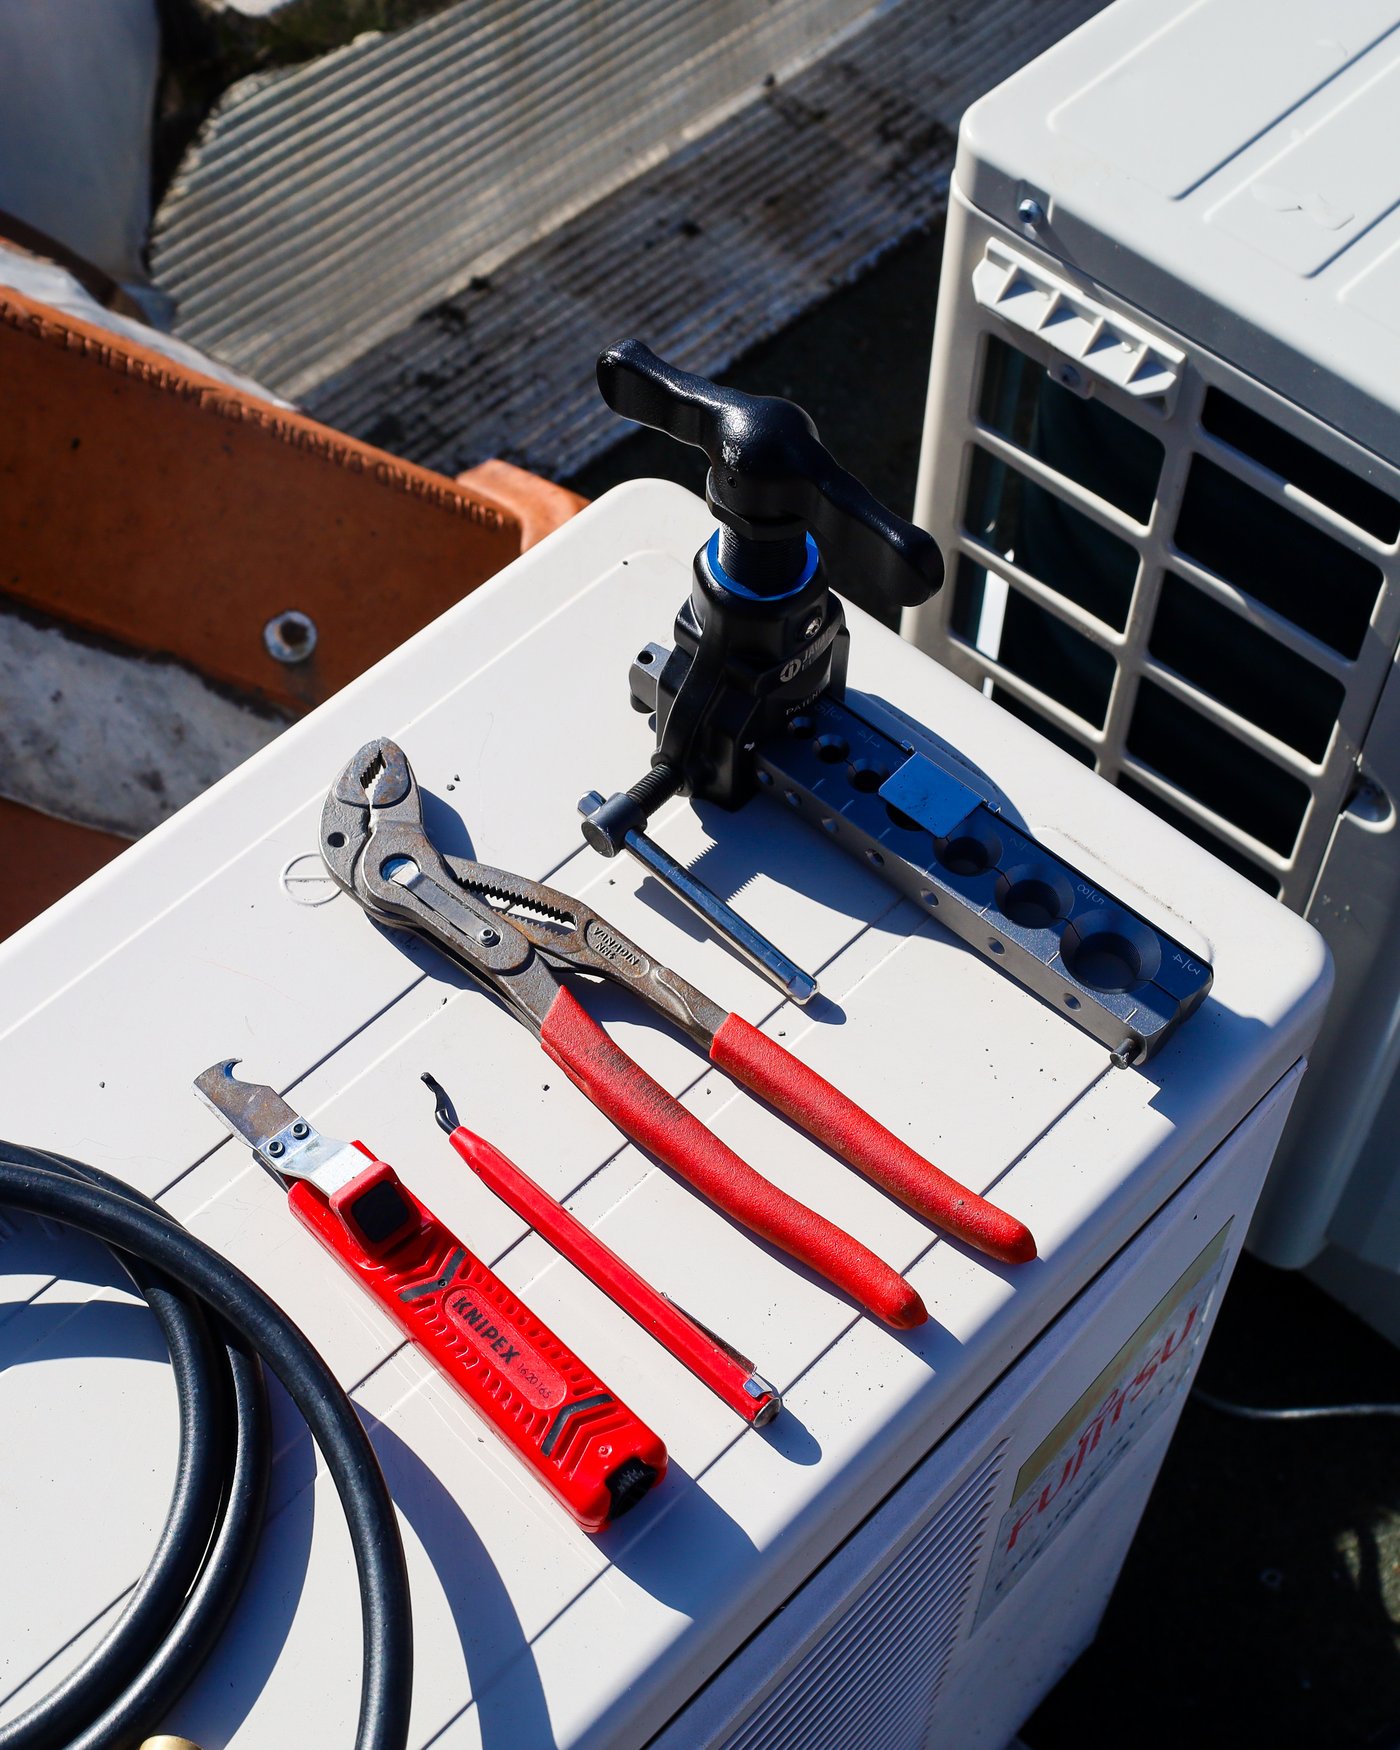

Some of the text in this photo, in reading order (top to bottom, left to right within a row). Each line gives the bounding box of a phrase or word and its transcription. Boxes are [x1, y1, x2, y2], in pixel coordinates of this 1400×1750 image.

[1076, 883, 1105, 905] 5/8
[593, 926, 640, 966] VANADIN
[1171, 952, 1201, 976] 3/4
[452, 1296, 521, 1365] KNIPEX
[1006, 1304, 1198, 1553] FUJITSU
